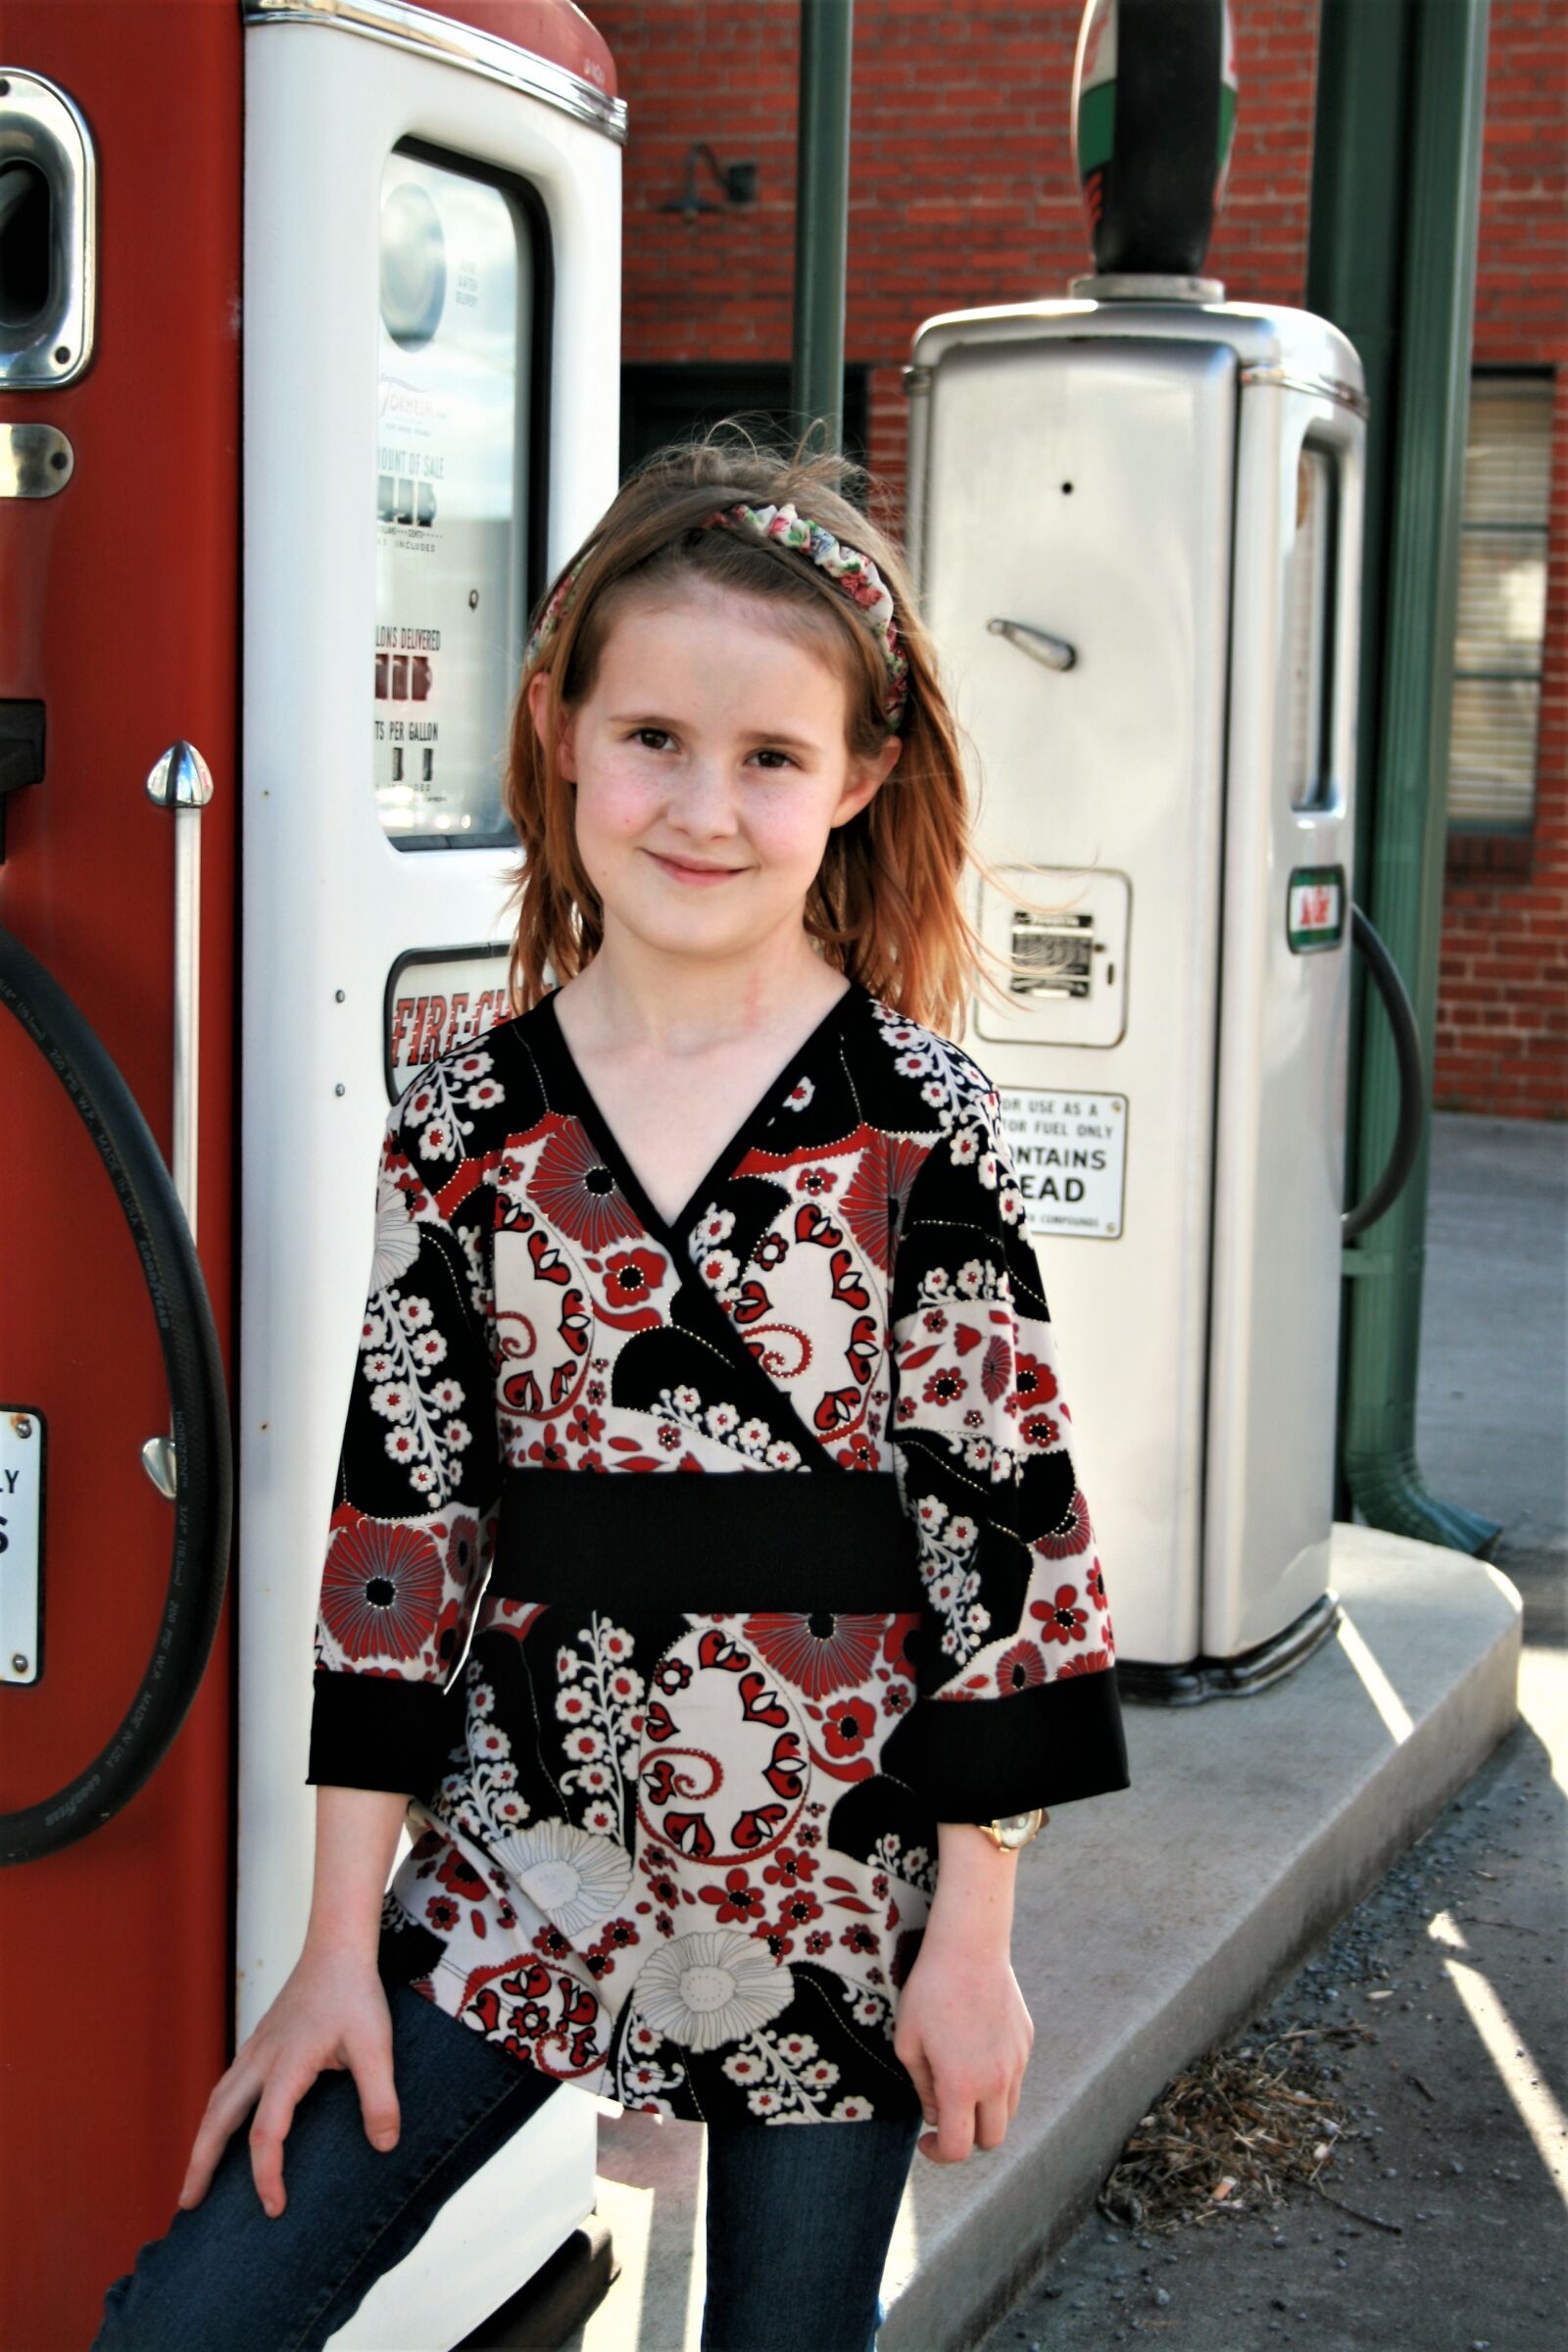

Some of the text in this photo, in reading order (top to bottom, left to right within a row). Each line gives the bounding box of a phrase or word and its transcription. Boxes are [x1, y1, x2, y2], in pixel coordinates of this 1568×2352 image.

[377, 447, 445, 479] OUNT OF SALE
[376, 625, 441, 651] LONS DELIVERED
[390, 721, 405, 741] PER
[409, 722, 439, 742] GALLON
[1002, 1098, 1098, 1116] OR USE AS A
[1035, 1121, 1067, 1136] FUEL
[1077, 1123, 1113, 1139] ONLY
[95, 1134, 121, 1174] MADE
[117, 1175, 128, 1193] IN
[1009, 1144, 1106, 1170] NTAINS
[1020, 1174, 1085, 1202] EAD
[138, 1240, 170, 1329] GOODYEAR
[168, 1599, 179, 1624] 200
[161, 1628, 173, 1650] PSI
[130, 1690, 152, 1730] MADE
